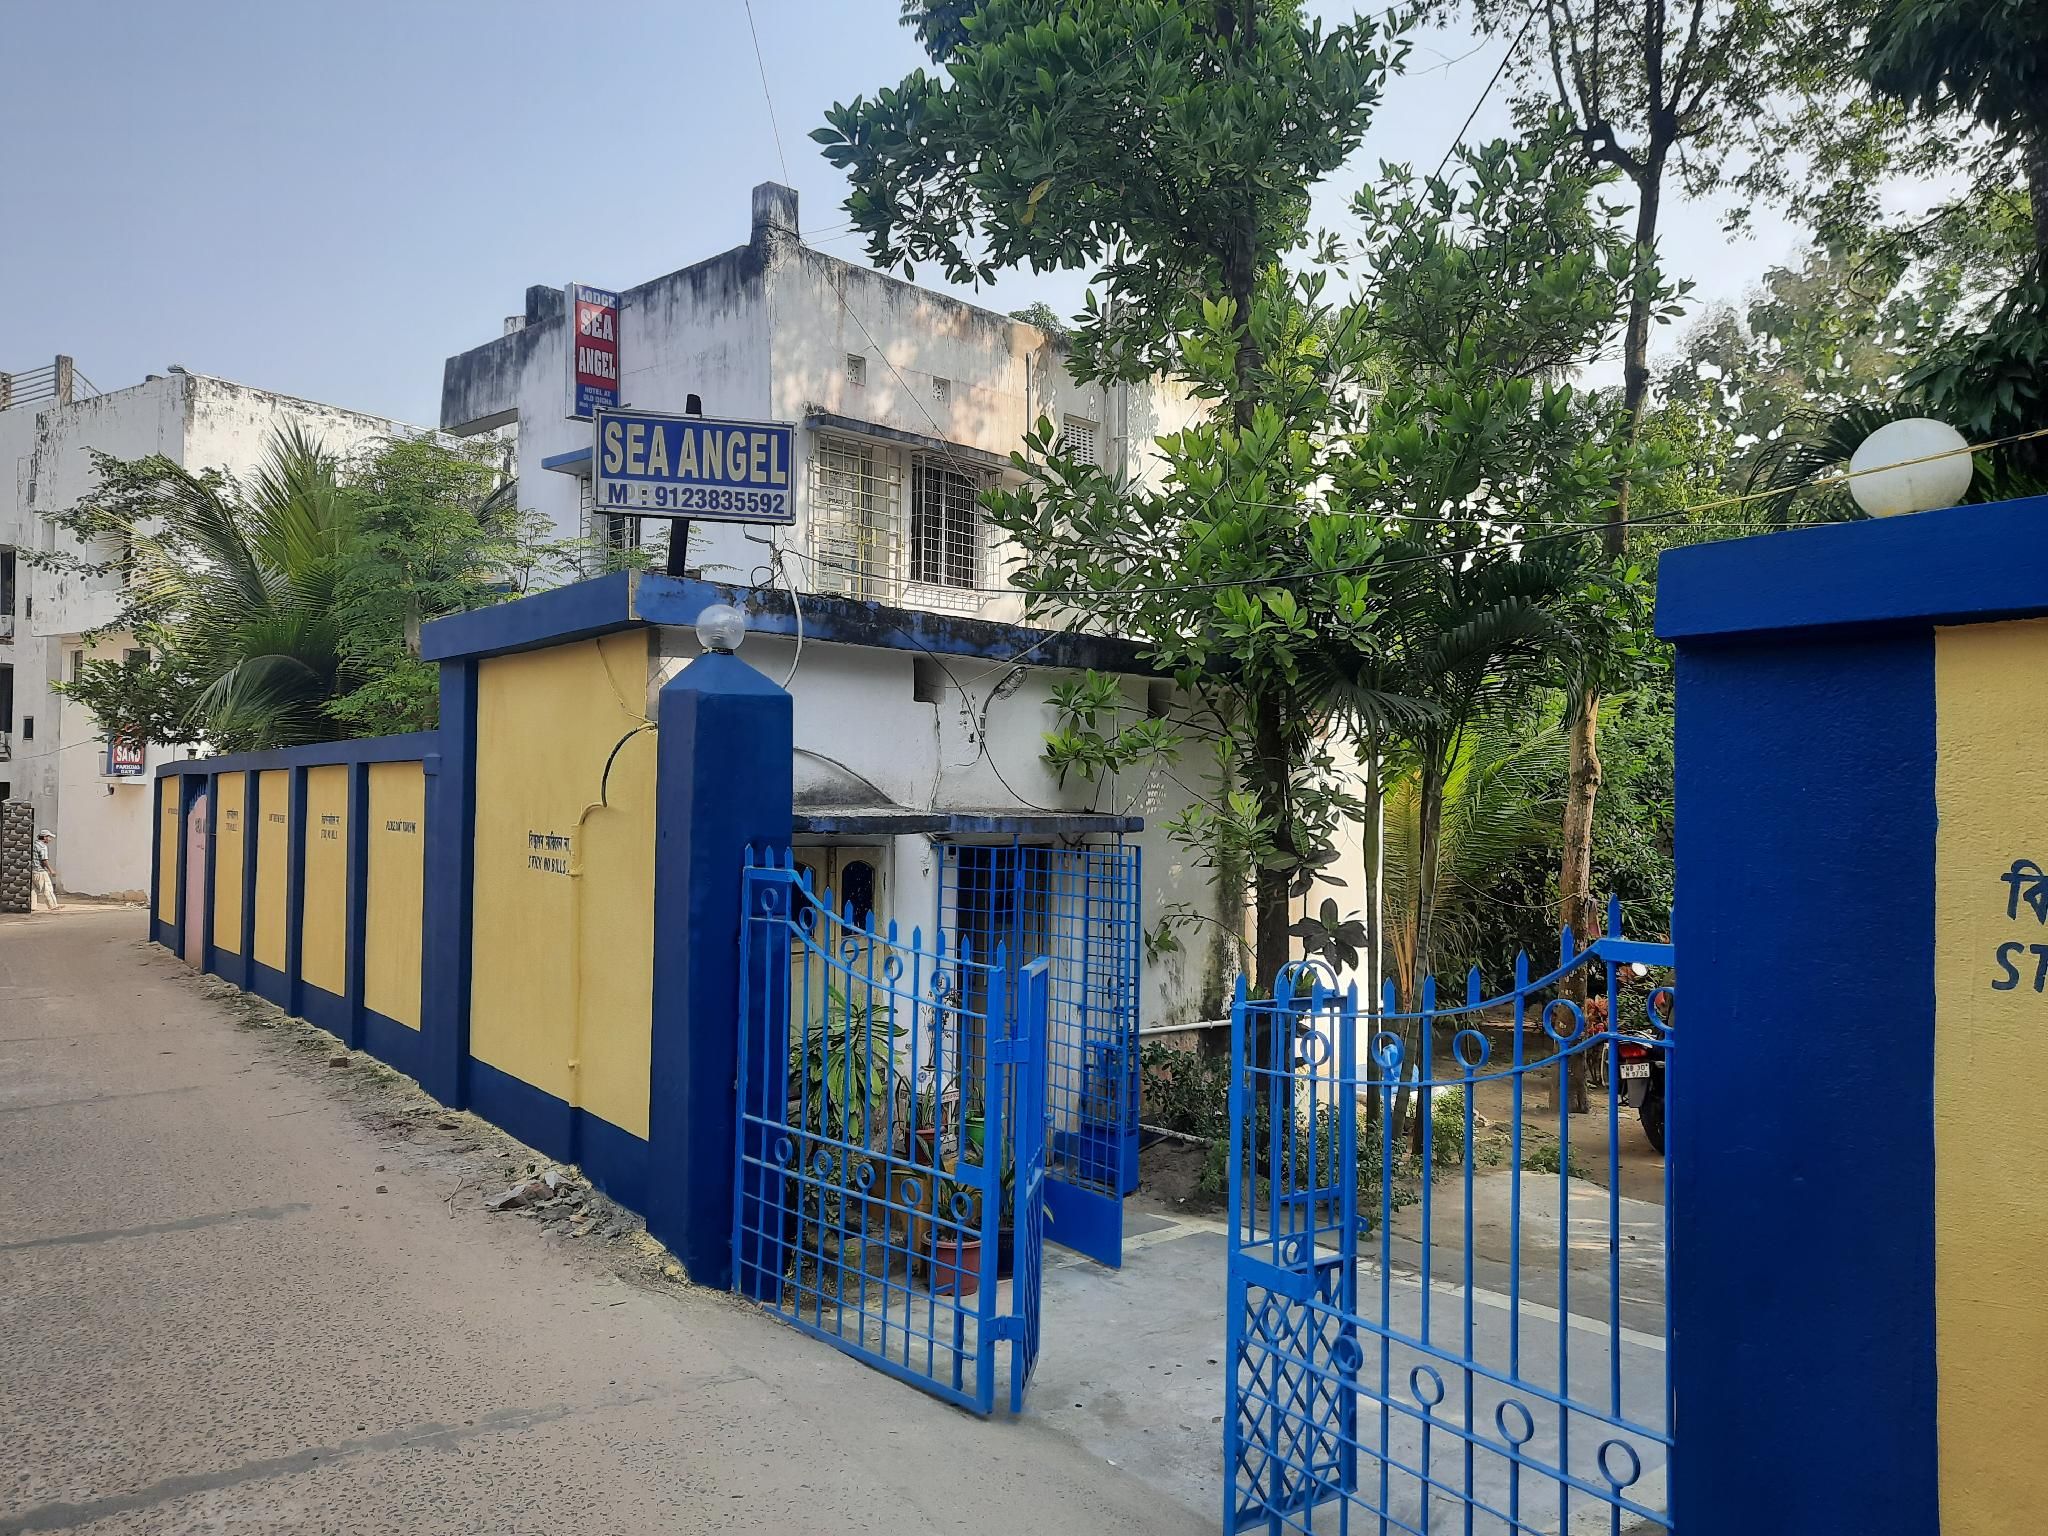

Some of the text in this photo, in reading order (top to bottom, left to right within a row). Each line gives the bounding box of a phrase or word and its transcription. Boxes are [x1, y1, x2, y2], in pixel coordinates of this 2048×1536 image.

[578, 288, 616, 309] LODGE
[580, 308, 614, 342] SEA
[578, 346, 616, 380] ANGEL
[604, 421, 786, 485] SEA ANGEL
[655, 486, 785, 514] 9123835592
[117, 745, 140, 763] SAND
